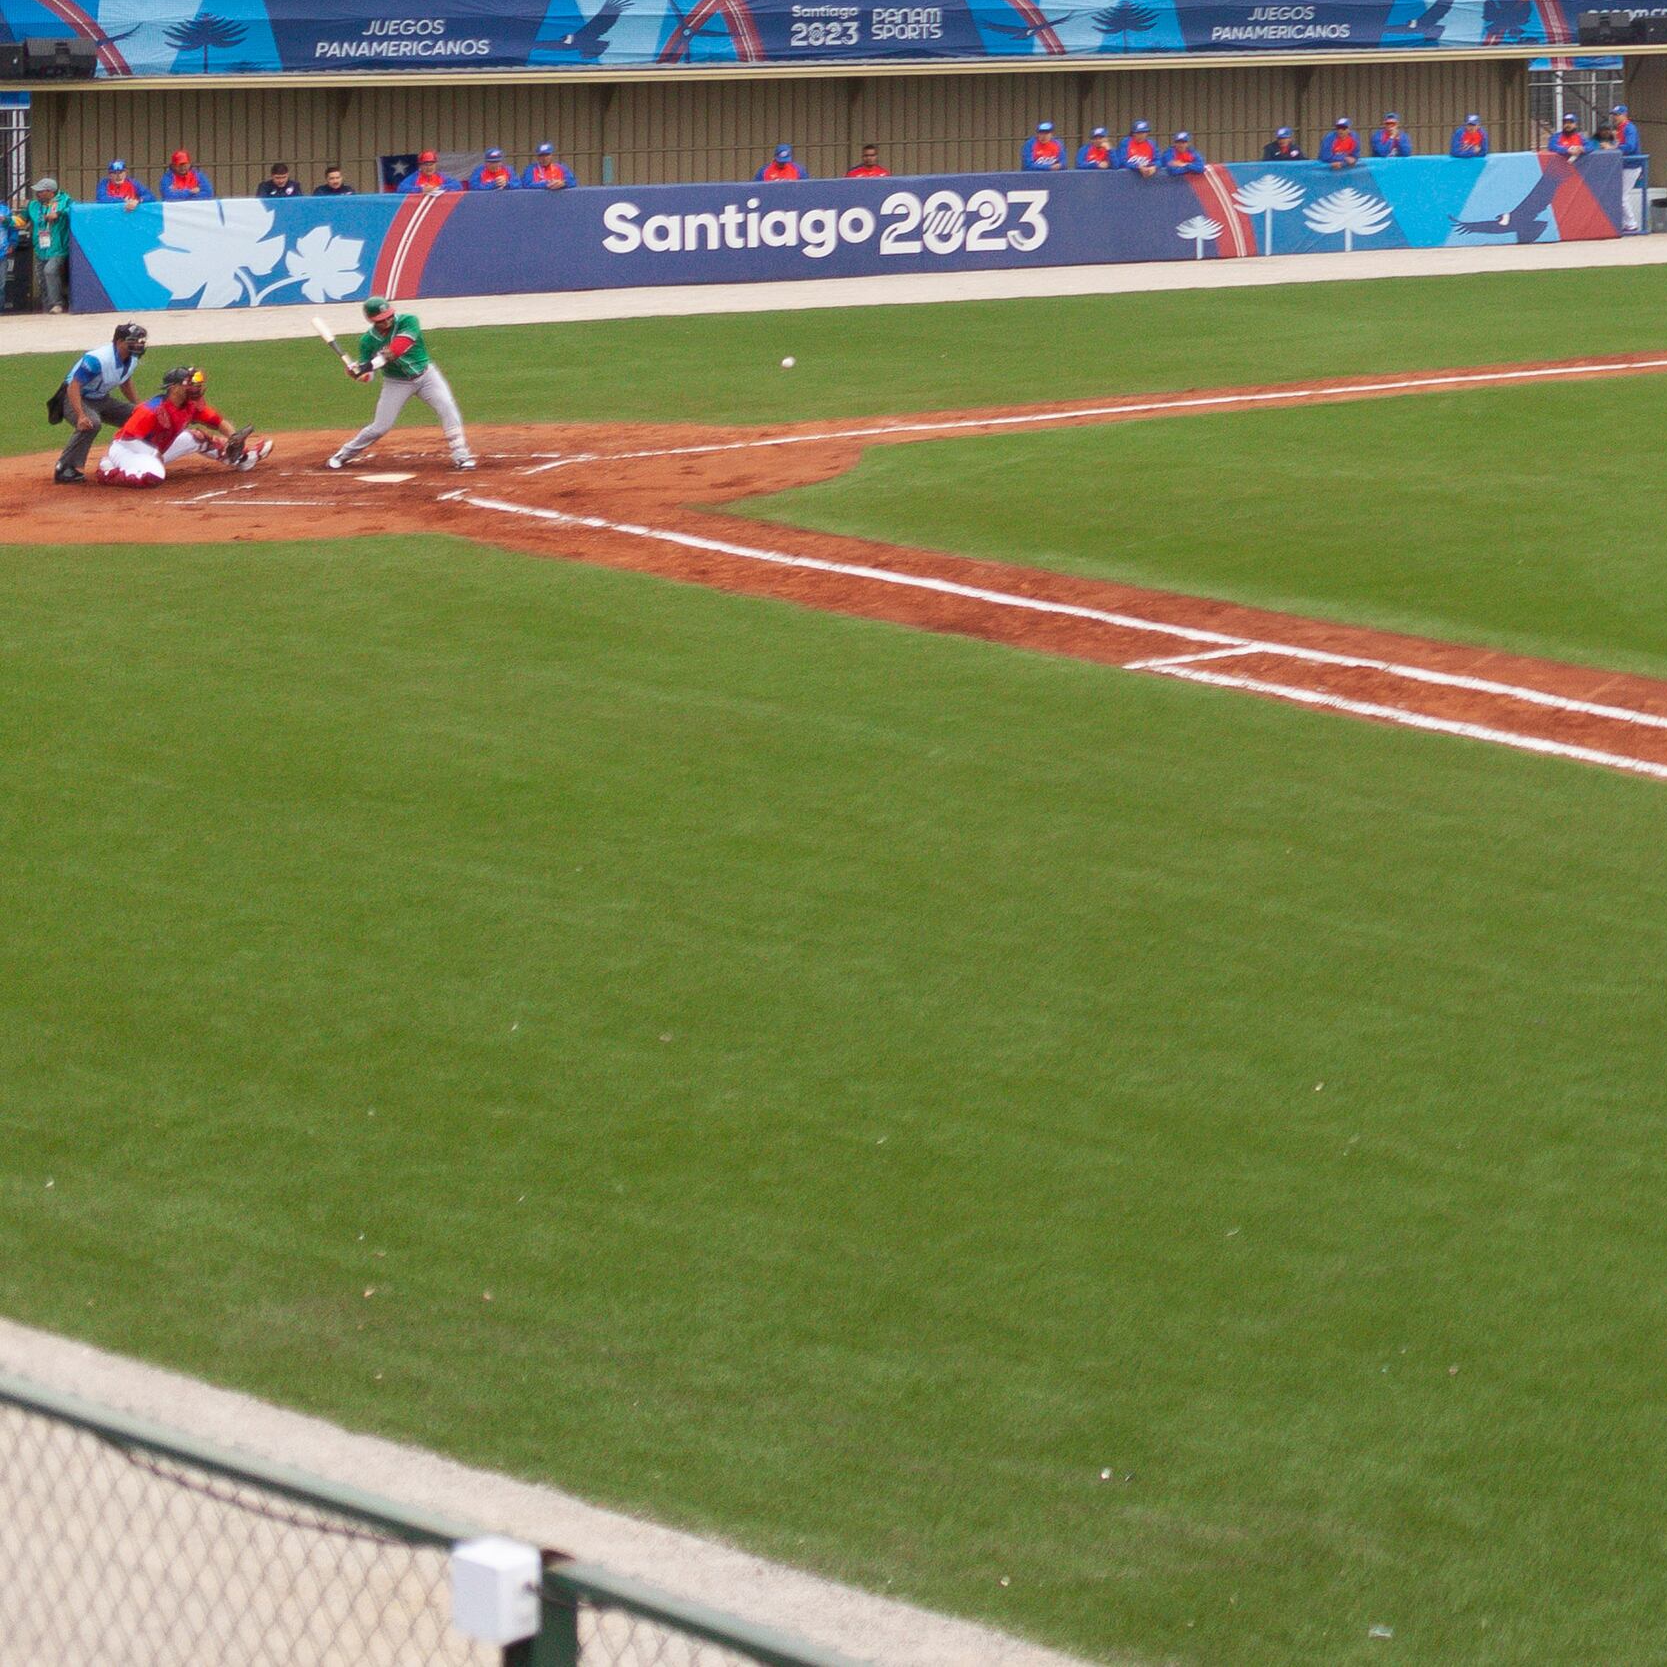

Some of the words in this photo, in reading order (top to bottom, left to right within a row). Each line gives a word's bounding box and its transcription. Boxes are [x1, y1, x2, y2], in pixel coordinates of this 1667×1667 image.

[791, 4, 859, 19] Santiago
[1247, 6, 1316, 21] JUEGOS
[361, 19, 446, 36] JUEGOS
[790, 21, 860, 46] 2023
[871, 23, 942, 41] SPORTS
[1211, 24, 1350, 41] PANAMERICANOS
[314, 38, 490, 58] PANAMERICANOS
[602, 198, 876, 258] Santiago
[879, 189, 1050, 255] 2023
